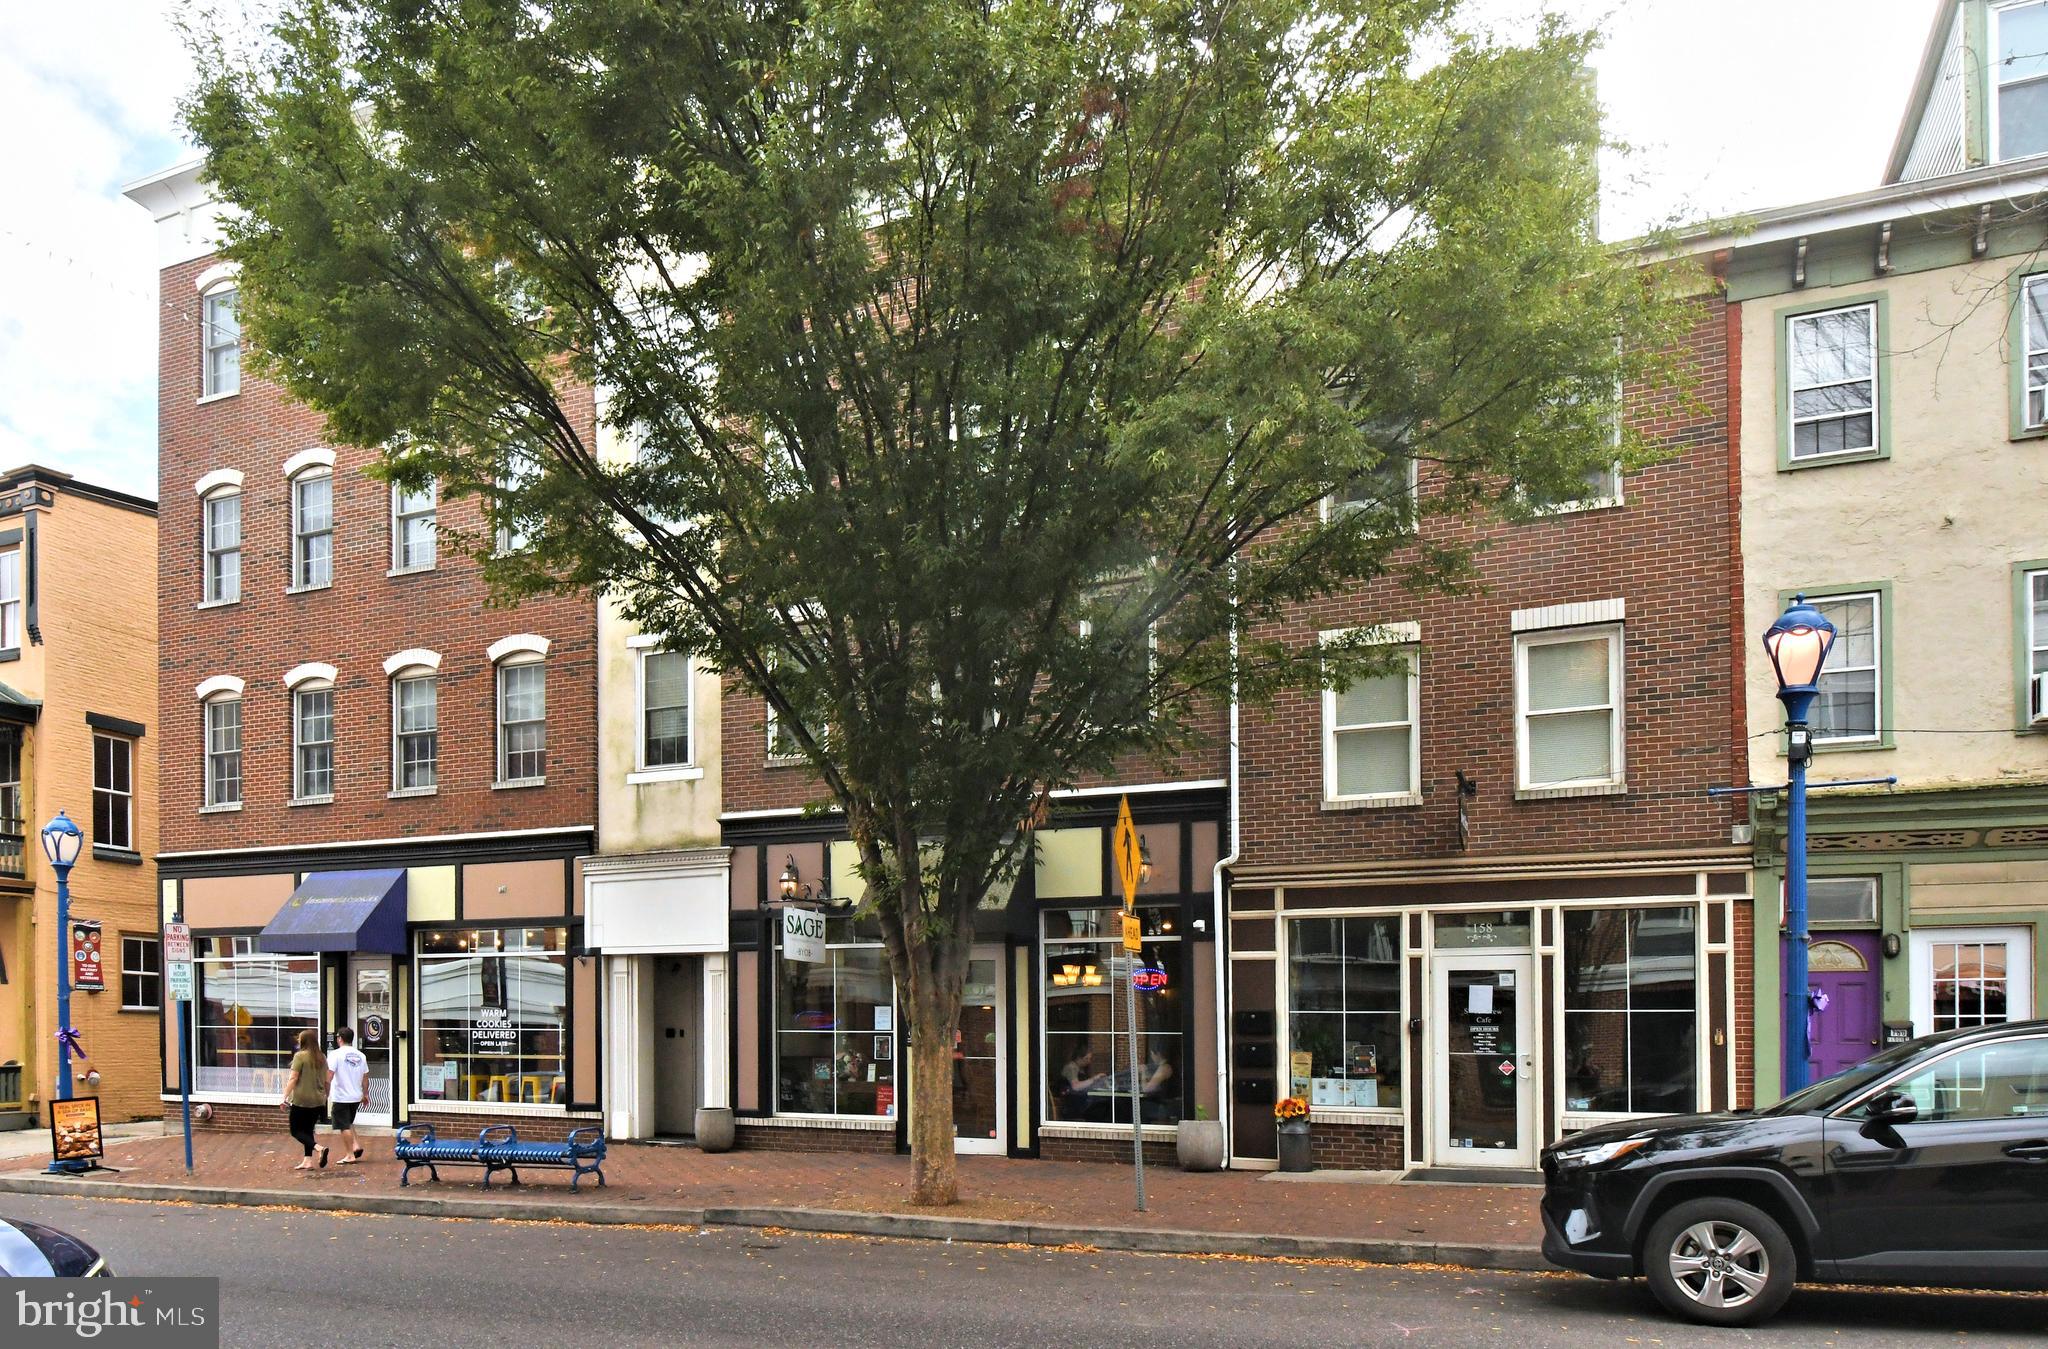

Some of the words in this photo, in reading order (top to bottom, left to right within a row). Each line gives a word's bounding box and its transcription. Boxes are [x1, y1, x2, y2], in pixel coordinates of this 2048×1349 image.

[786, 914, 824, 939] SAGE
[1474, 923, 1492, 934] 158
[481, 1009, 507, 1017] WARM
[476, 1020, 512, 1028] COOKIES
[472, 1031, 516, 1039] DELIVERED
